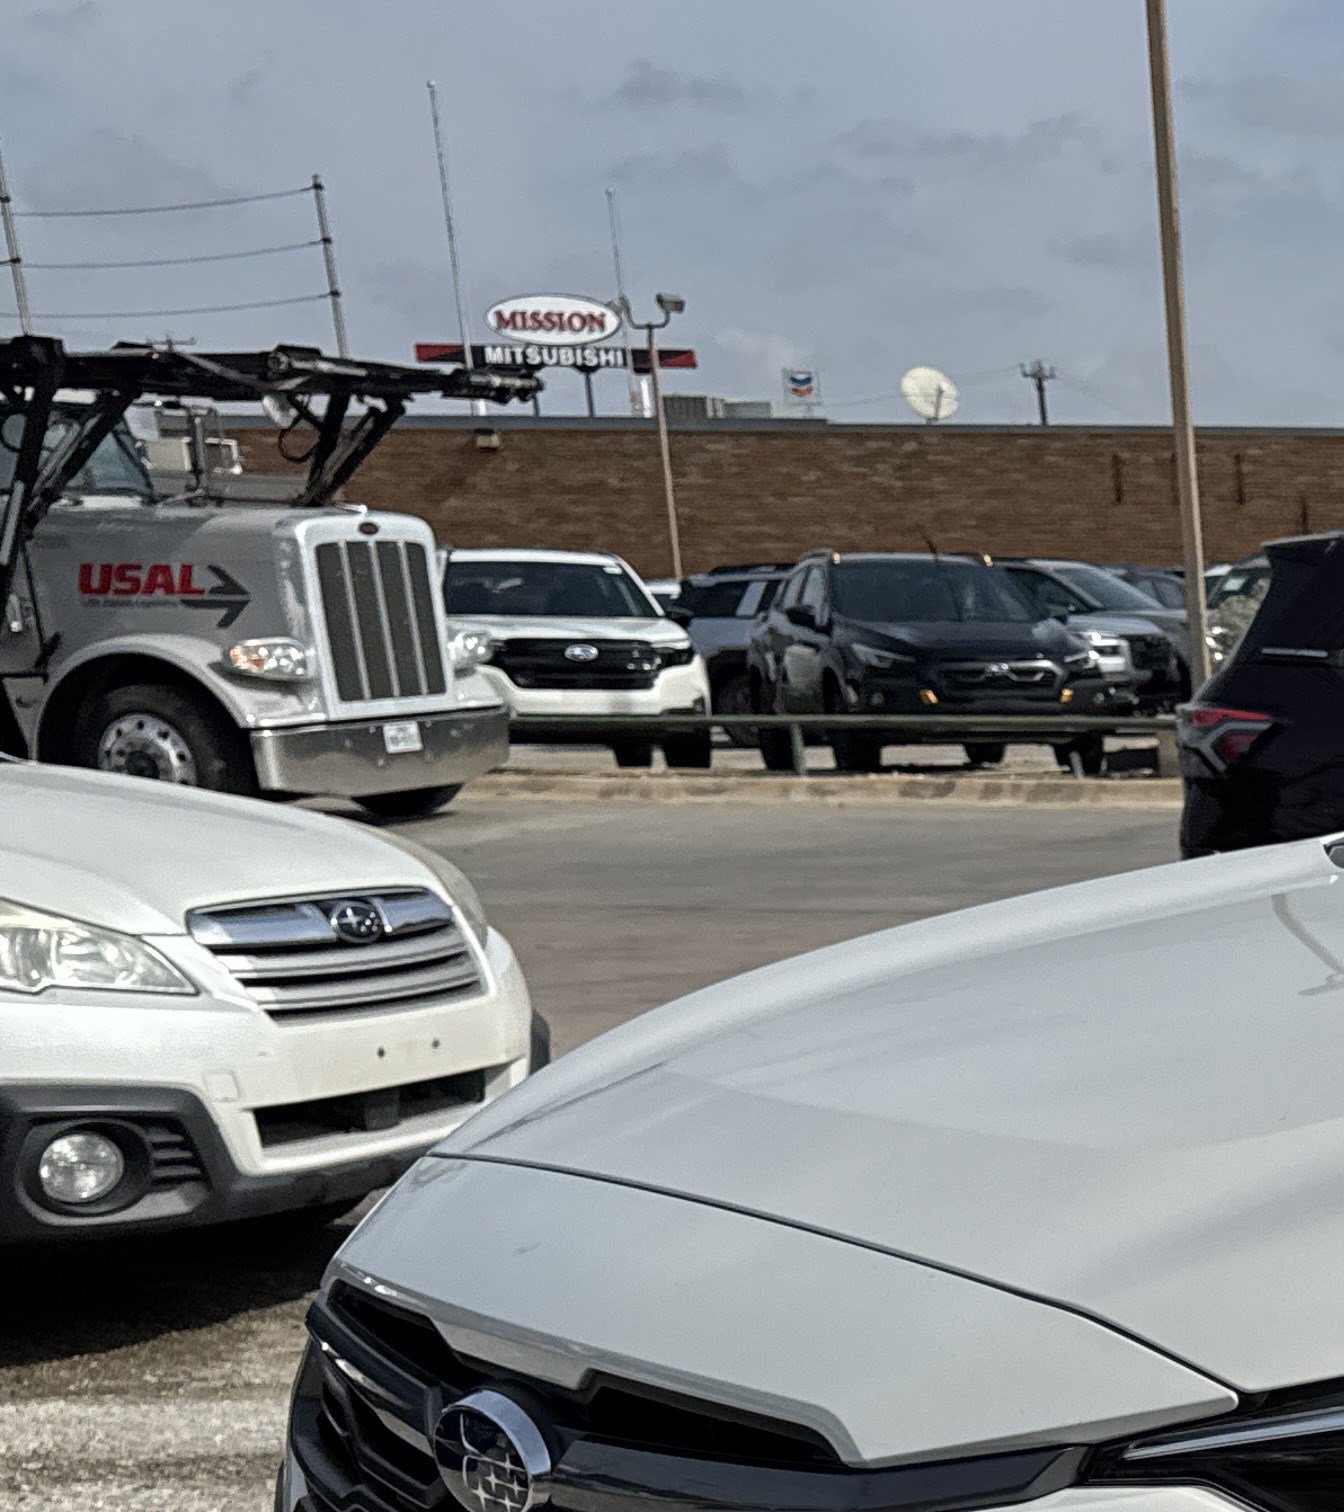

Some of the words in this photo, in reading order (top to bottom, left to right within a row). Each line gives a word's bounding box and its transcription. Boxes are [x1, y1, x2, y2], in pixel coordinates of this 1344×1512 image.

[494, 310, 606, 333] MISSION
[484, 345, 624, 367] MITSUBISHI
[79, 562, 205, 596] USAL
